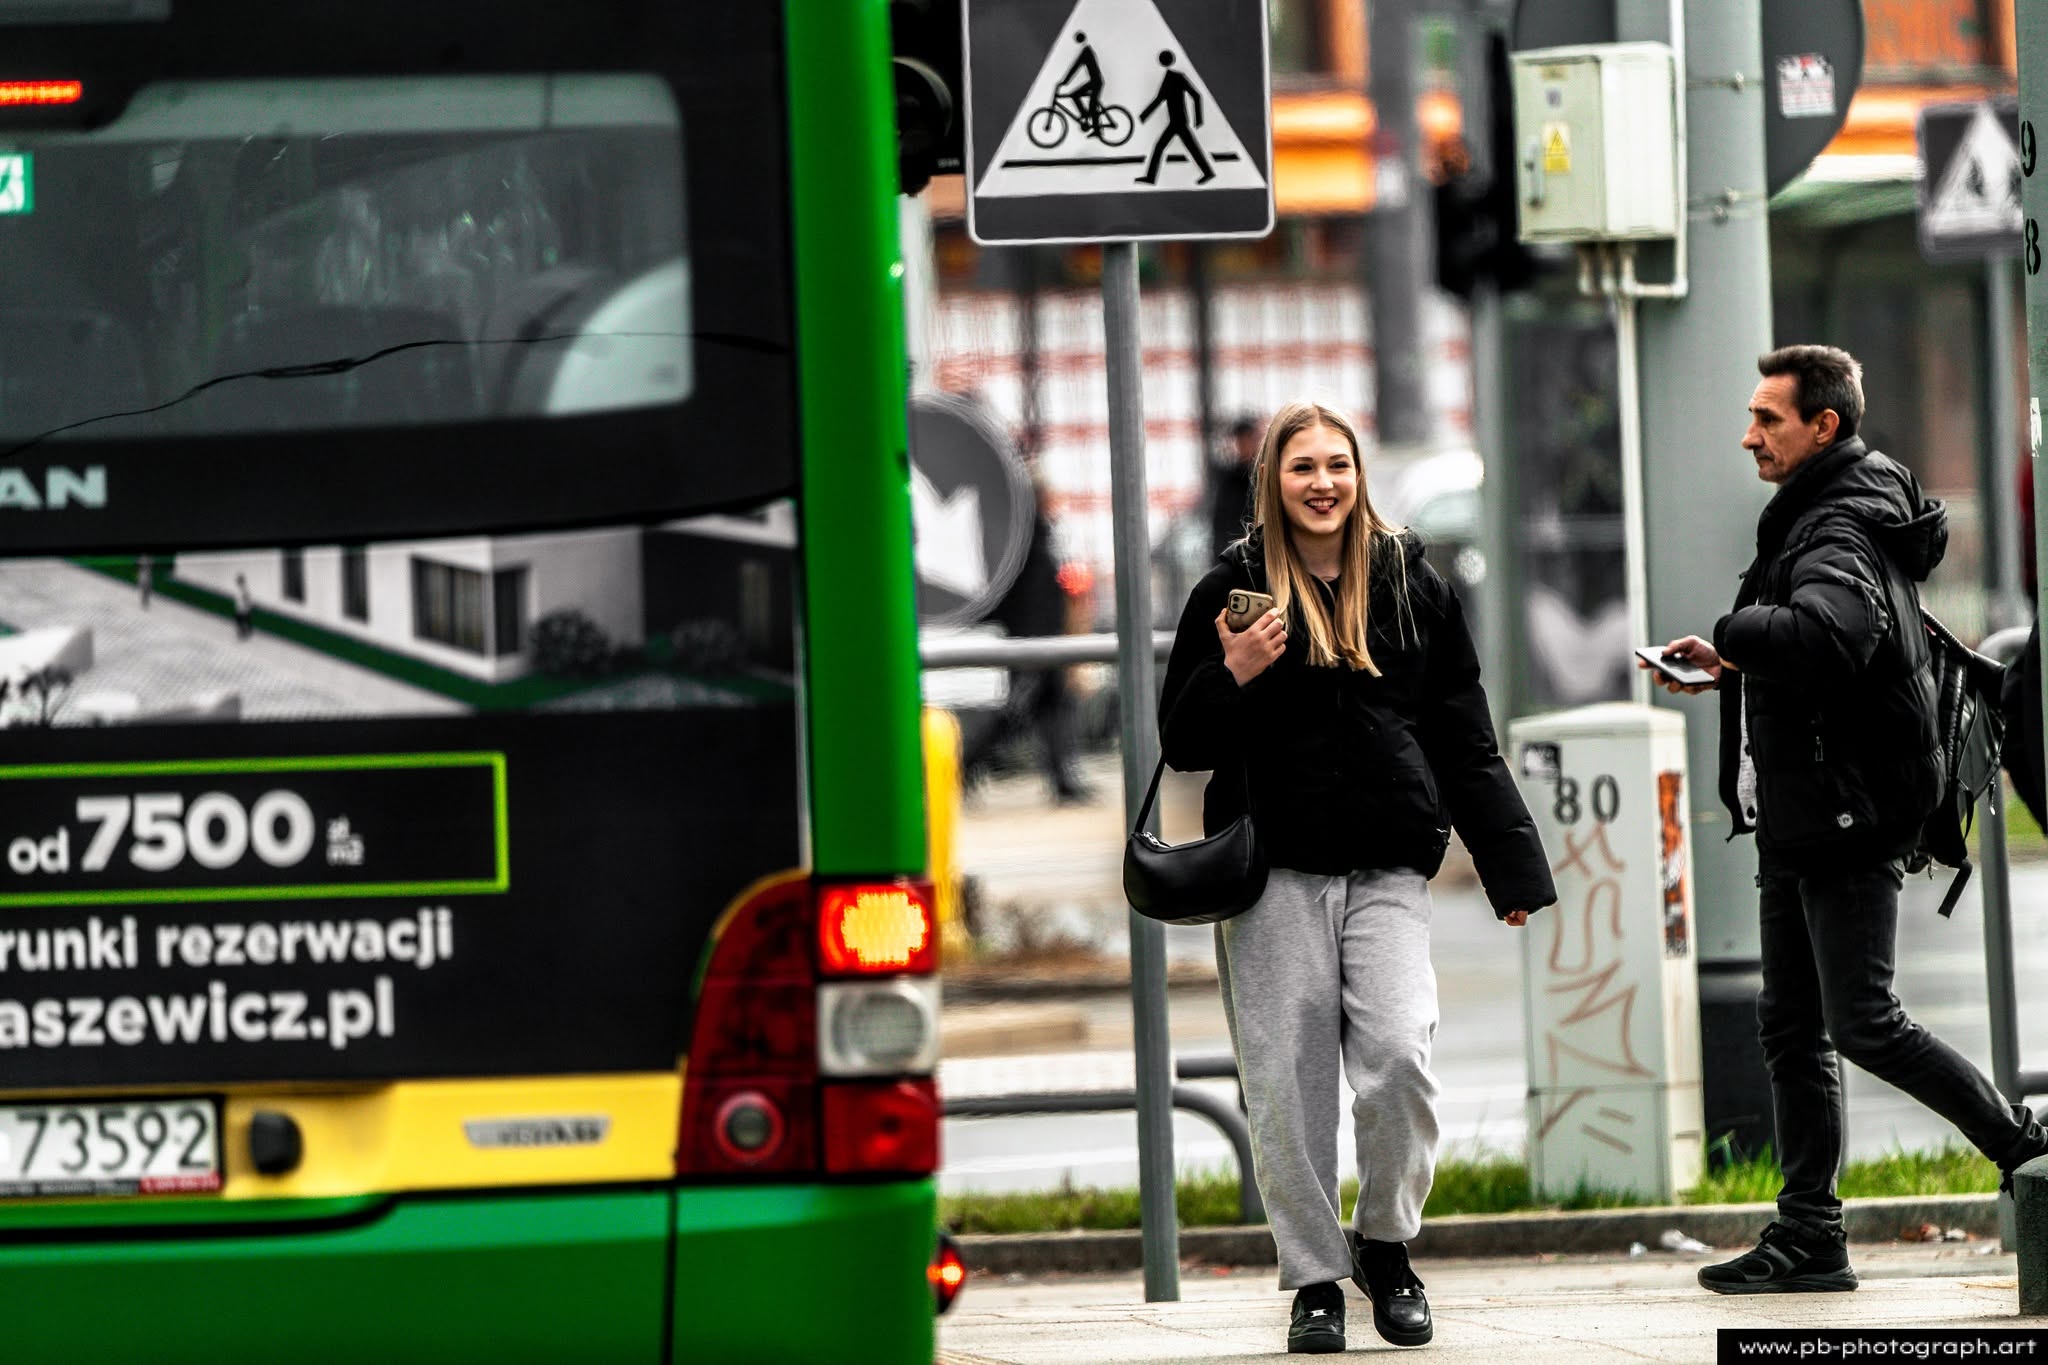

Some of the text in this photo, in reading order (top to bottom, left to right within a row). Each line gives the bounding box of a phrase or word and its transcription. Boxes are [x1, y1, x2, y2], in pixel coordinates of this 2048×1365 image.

[8, 827, 70, 874] od
[76, 790, 315, 871] 7500
[1553, 774, 1620, 825] 80
[0, 907, 453, 972] runki rezerwacji
[0, 976, 395, 1049] aszewicz.pl
[16, 1107, 210, 1174] 73592
